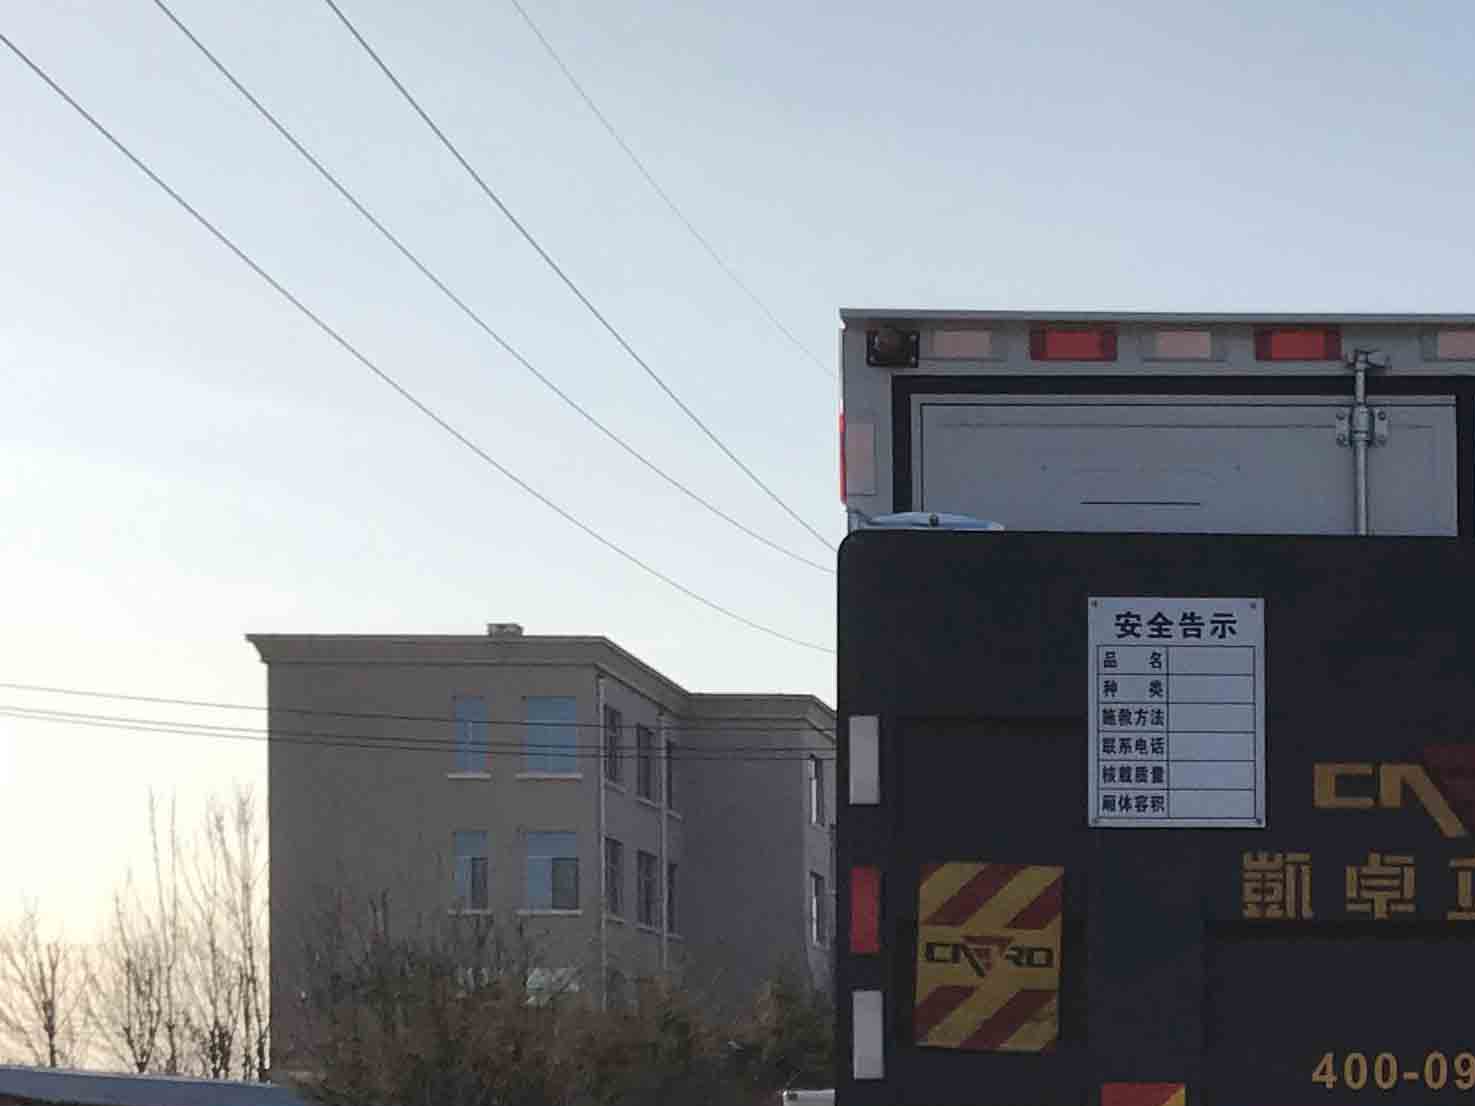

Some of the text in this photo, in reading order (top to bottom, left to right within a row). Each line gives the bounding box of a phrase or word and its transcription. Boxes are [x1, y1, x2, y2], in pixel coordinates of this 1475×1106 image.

[1114, 610, 1238, 640] 安全告示
[1101, 737, 1165, 756] 联系电话
